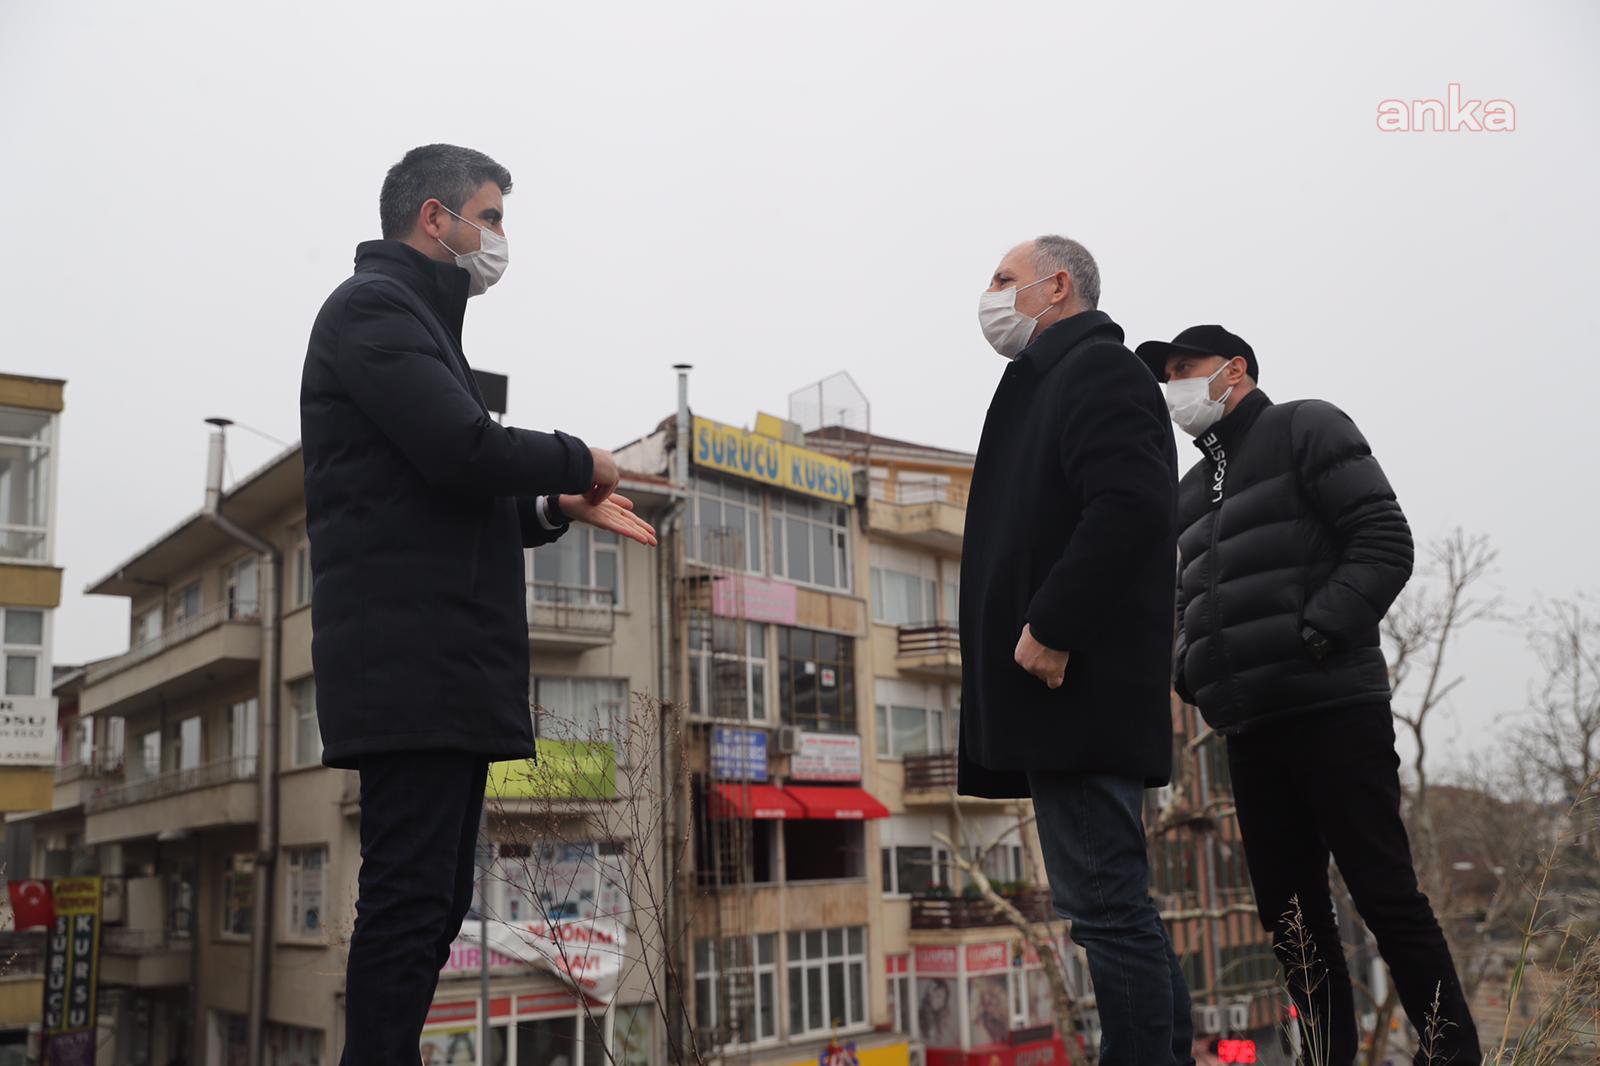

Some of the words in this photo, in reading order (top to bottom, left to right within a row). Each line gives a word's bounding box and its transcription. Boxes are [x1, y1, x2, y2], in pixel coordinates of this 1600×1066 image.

[699, 421, 779, 481] SÜRÜCÜ
[792, 455, 850, 500] KURSU
[1202, 432, 1227, 503] LACOSTE
[71, 914, 92, 1026] KURSU
